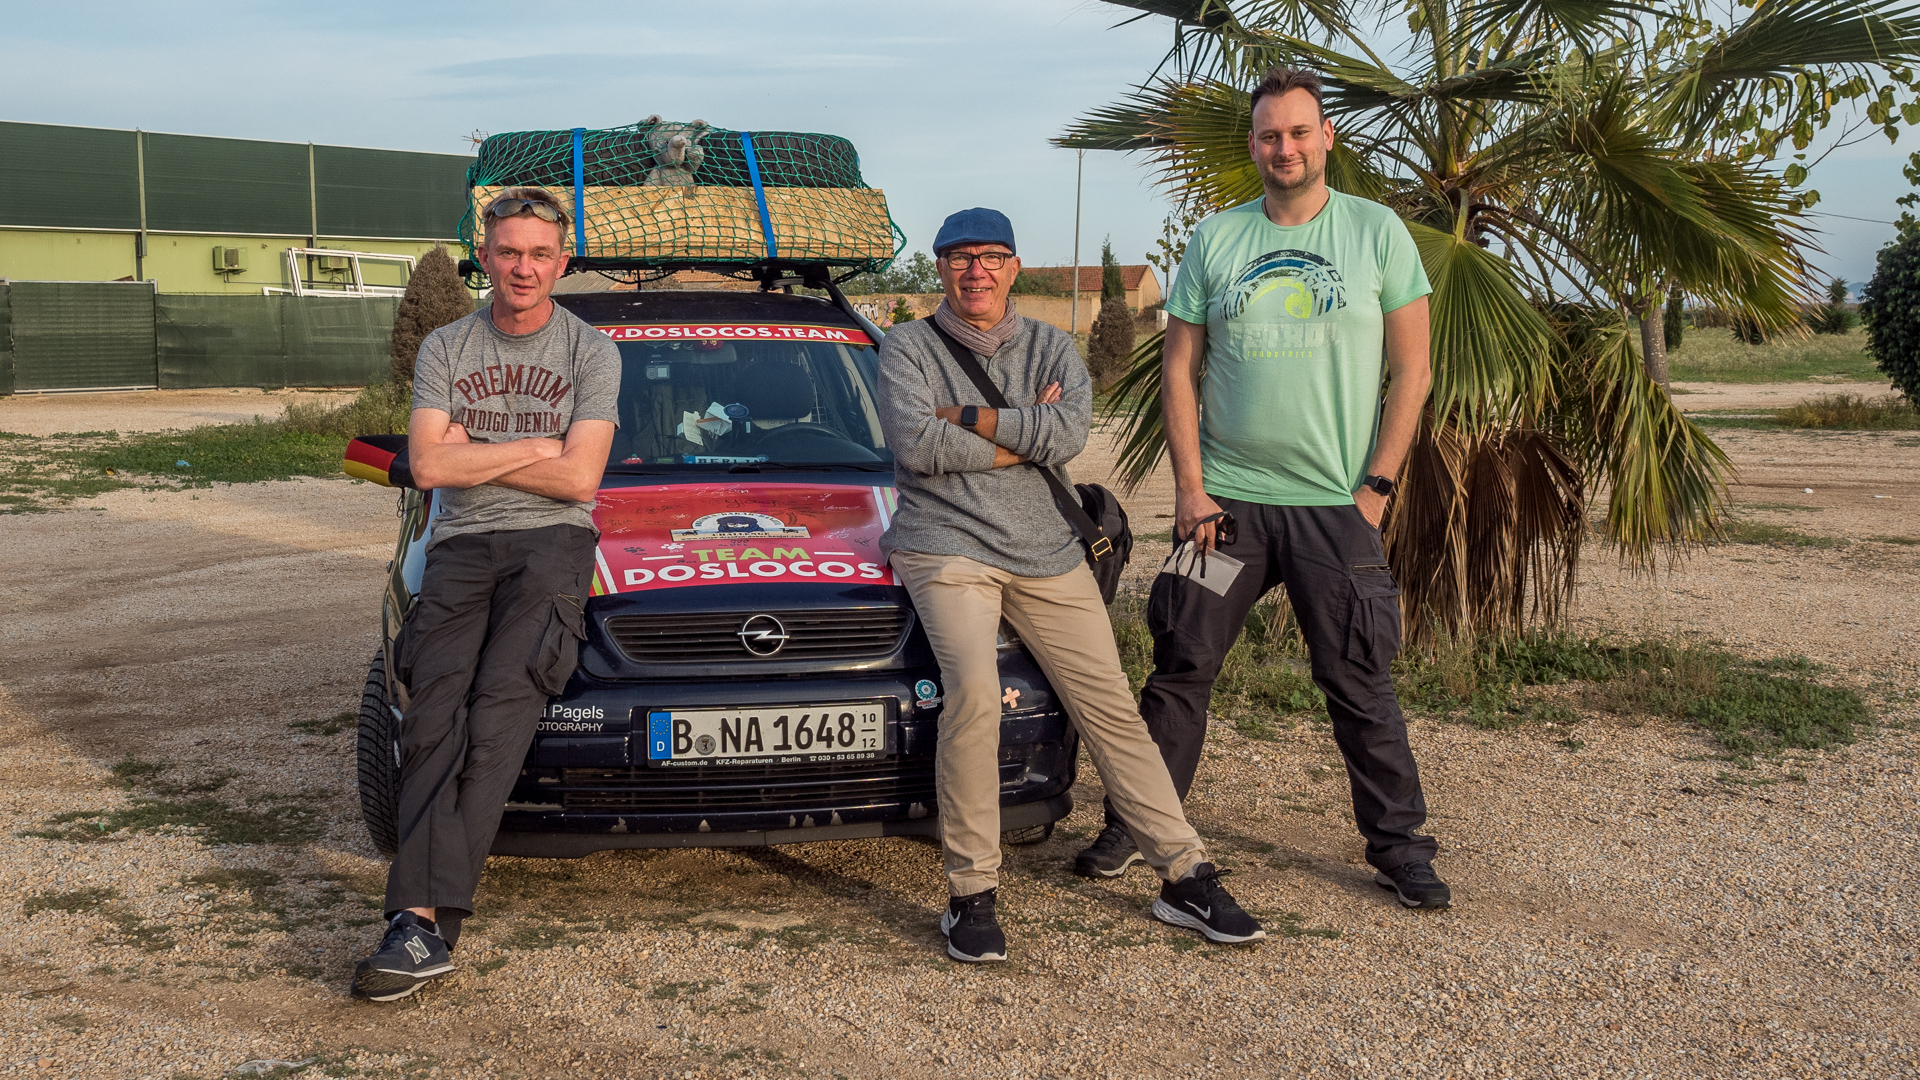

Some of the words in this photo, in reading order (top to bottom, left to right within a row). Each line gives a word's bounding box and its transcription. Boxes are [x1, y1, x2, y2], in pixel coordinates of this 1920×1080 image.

[1247, 350, 1313, 359] INDUSTRIES
[454, 363, 573, 409] PREMIUM
[461, 406, 509, 433] INDIGO
[514, 411, 562, 433] DENIM
[691, 547, 811, 562] TEAM
[623, 561, 884, 586] DOSLOCOS
[552, 704, 604, 722] Pagels
[862, 713, 876, 723] 10
[537, 722, 604, 732] OTOGRAPHY
[673, 719, 693, 754] B
[721, 716, 764, 753] NA
[773, 712, 856, 751] 1648
[656, 741, 665, 752] D
[862, 738, 876, 749] 12
[716, 758, 773, 766] KFZ-Reparaturen
[404, 935, 431, 965] N
